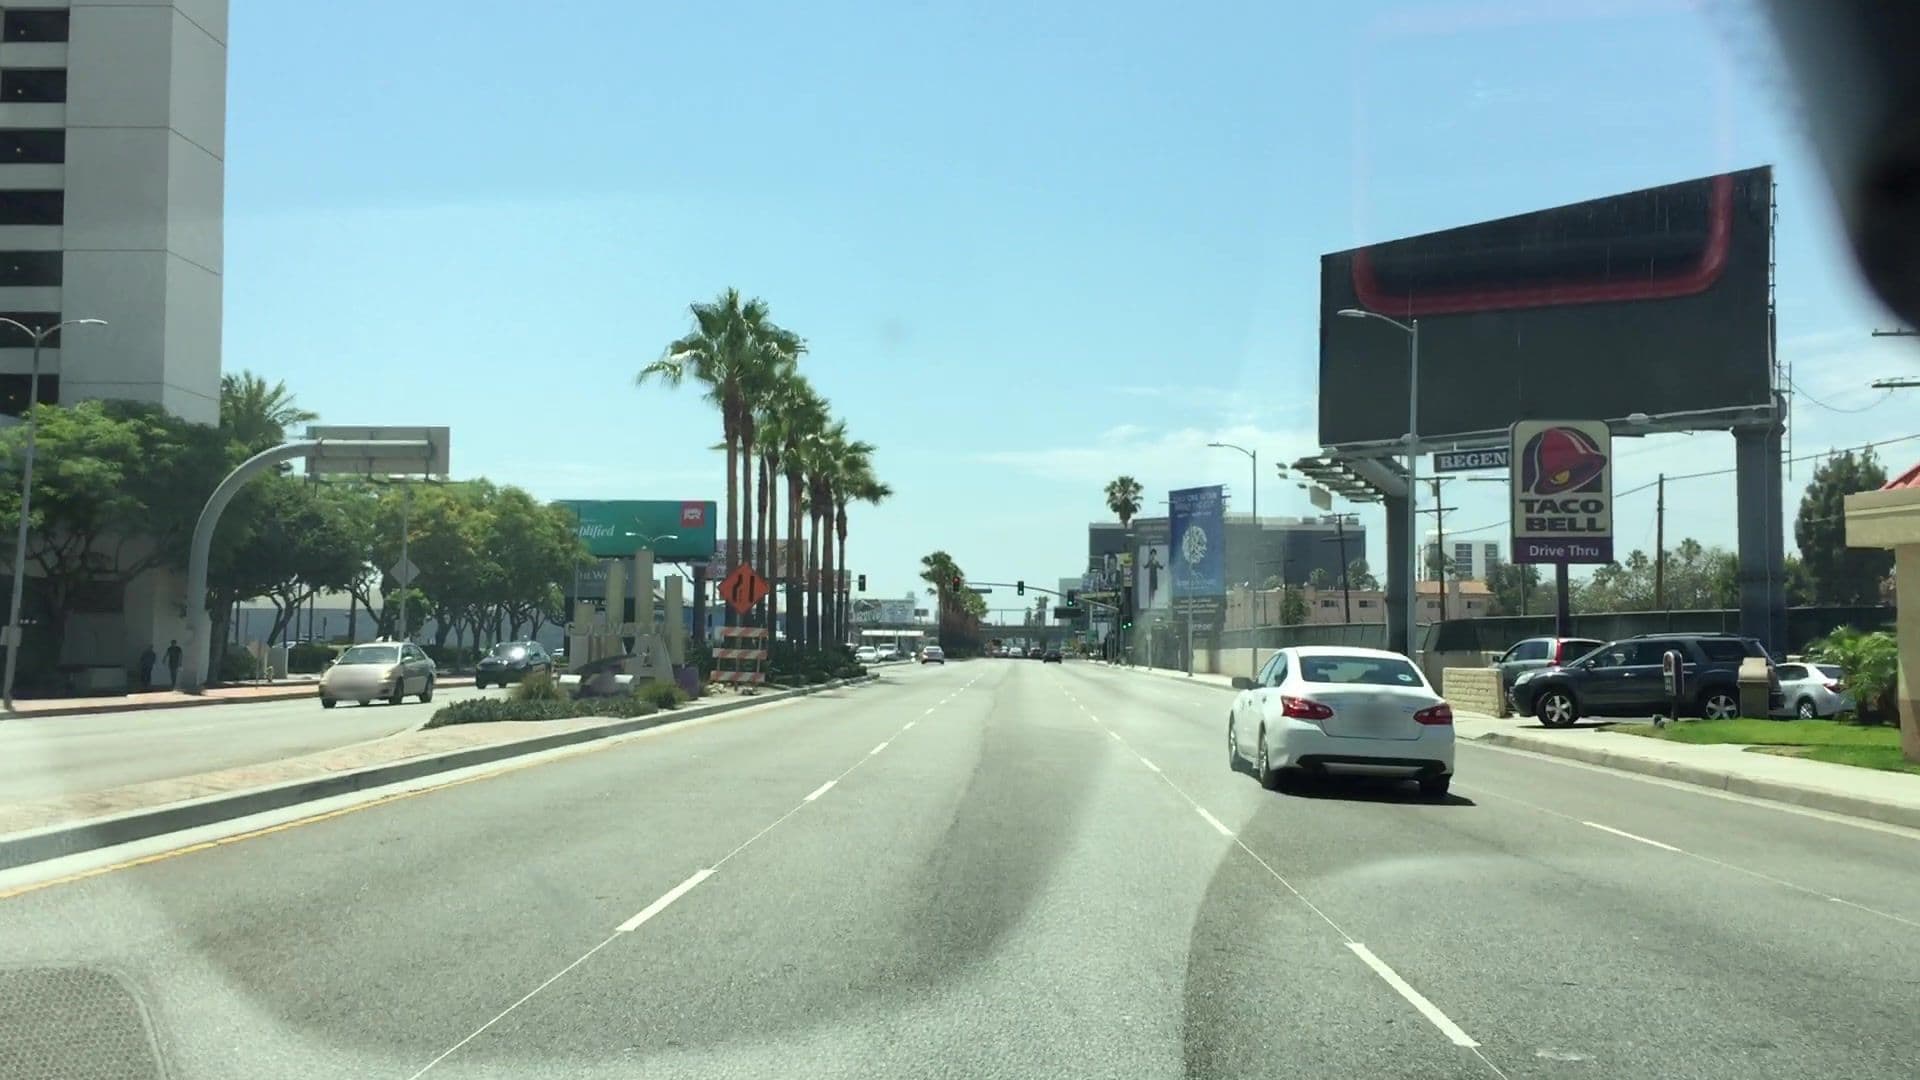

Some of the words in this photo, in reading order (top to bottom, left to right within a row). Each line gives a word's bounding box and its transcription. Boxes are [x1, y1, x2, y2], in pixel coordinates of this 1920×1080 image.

[1440, 451, 1511, 469] REGEN
[1520, 499, 1604, 514] TACO
[1526, 517, 1606, 532] BELL
[1529, 544, 1564, 557] Drive
[1568, 544, 1599, 557] Thru
